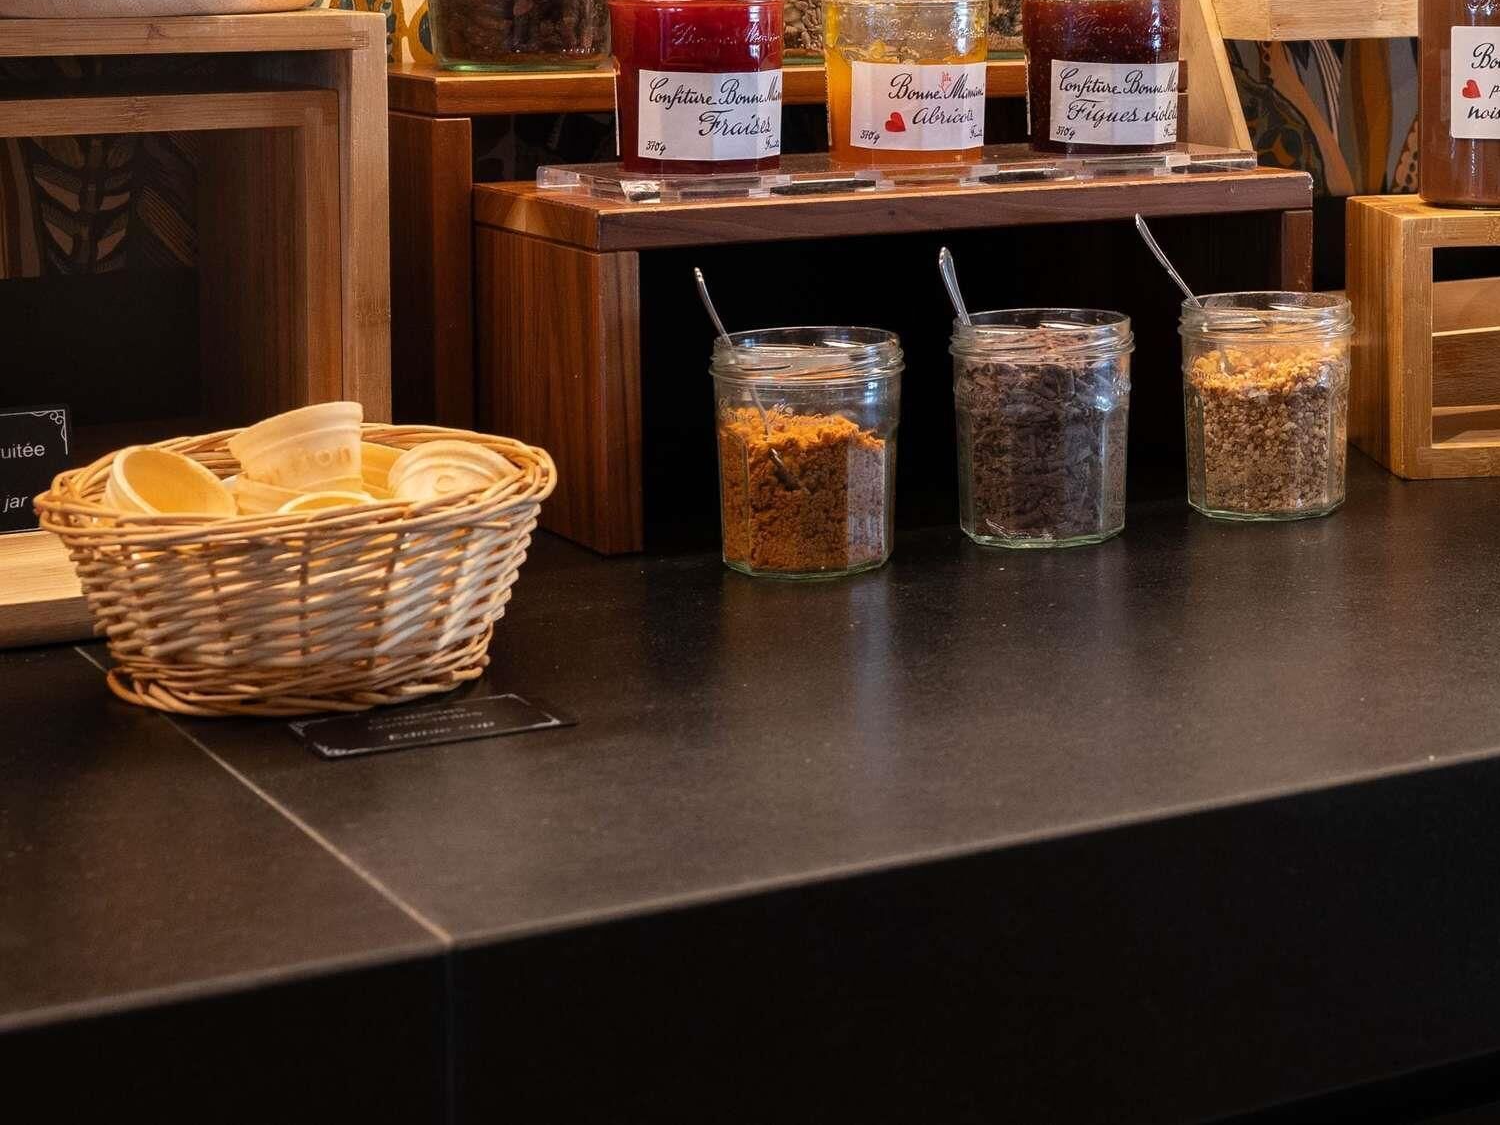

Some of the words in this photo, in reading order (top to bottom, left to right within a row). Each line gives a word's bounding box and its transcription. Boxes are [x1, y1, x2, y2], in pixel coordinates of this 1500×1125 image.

[649, 77, 716, 111] Confiture
[717, 78, 763, 105] Bonne
[887, 72, 942, 100] Bonne
[1059, 67, 1121, 98] Confiture
[1122, 69, 1162, 94] Bonne
[698, 109, 772, 136] Fraises
[1066, 98, 1139, 128] Figues
[0, 443, 46, 460] uitée
[2, 494, 29, 514] jar
